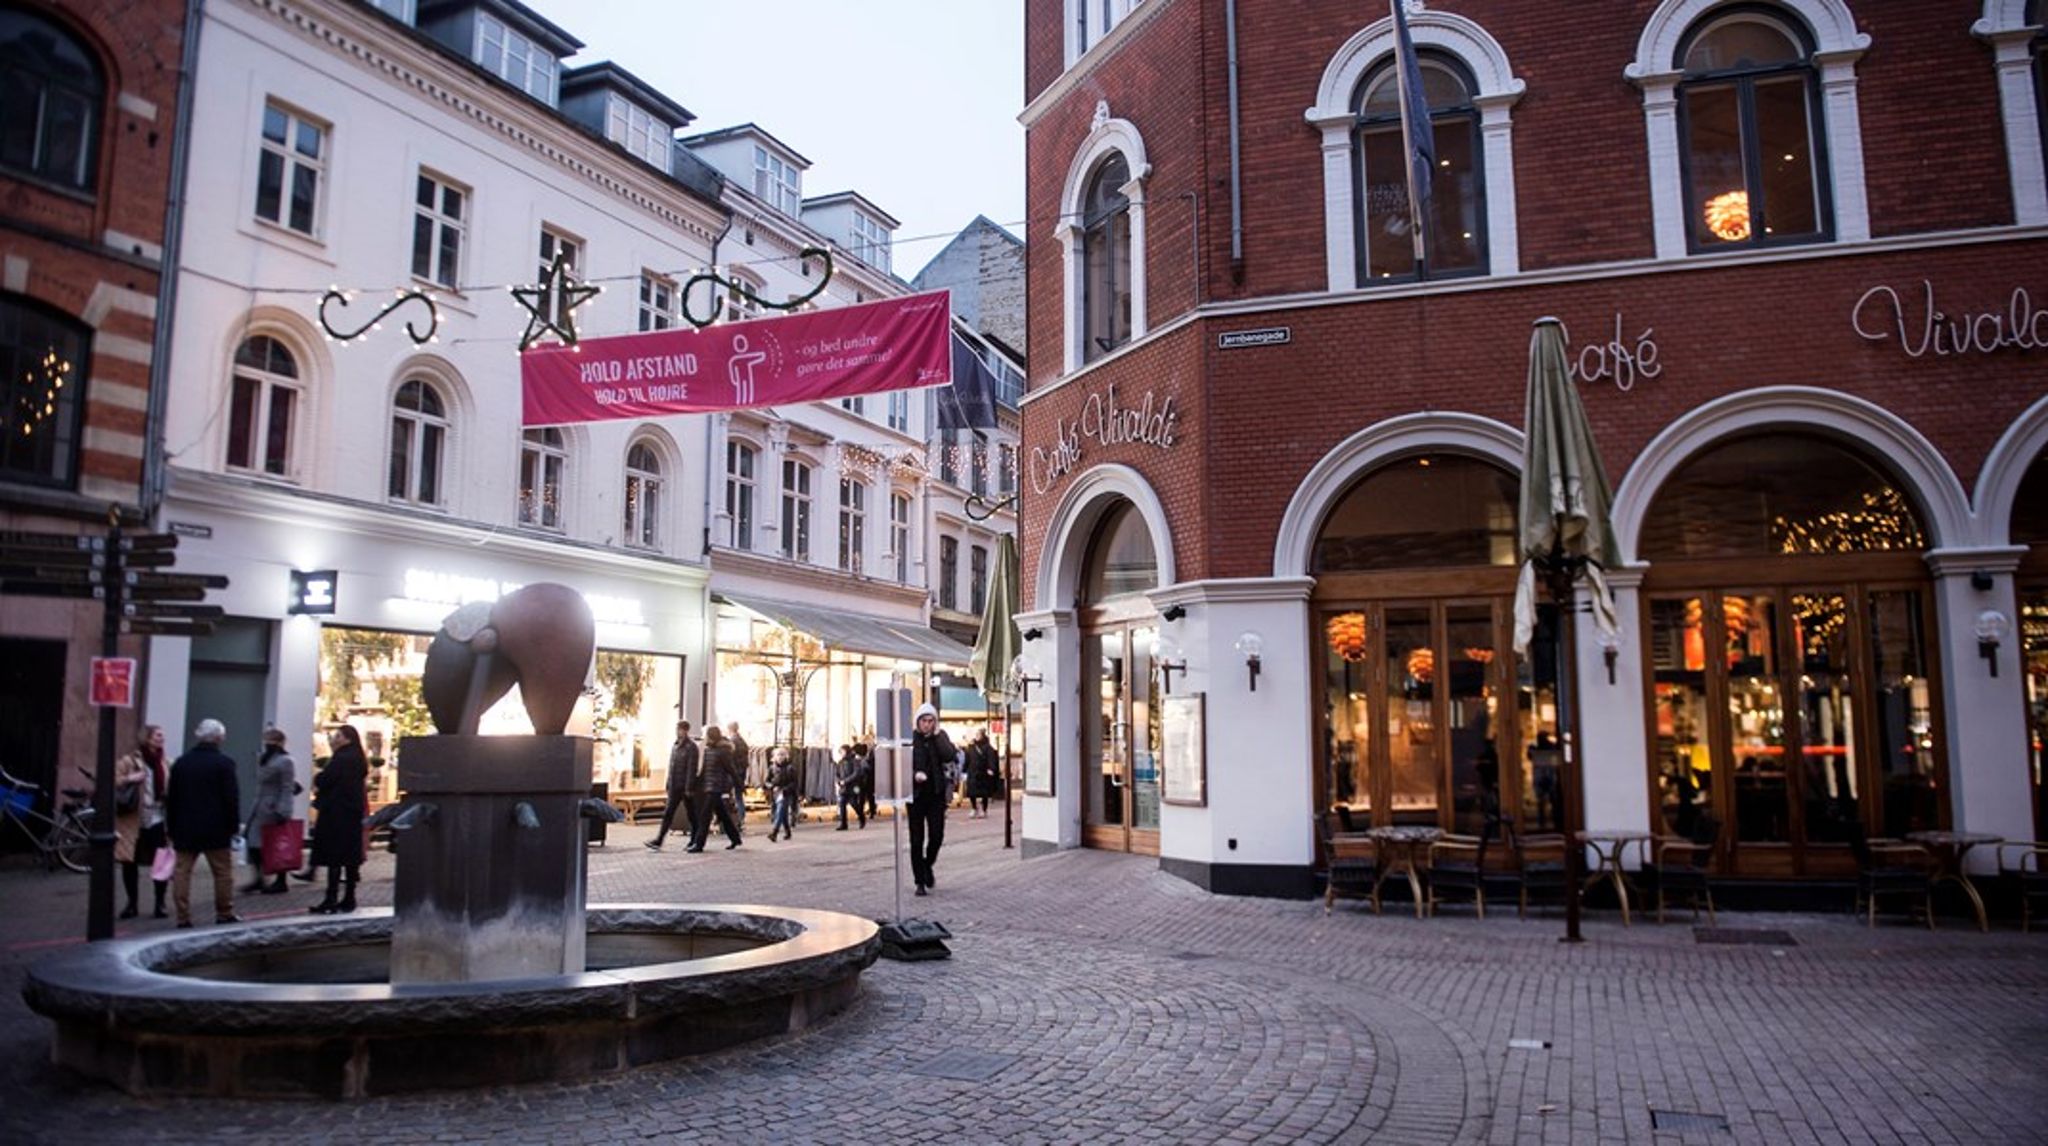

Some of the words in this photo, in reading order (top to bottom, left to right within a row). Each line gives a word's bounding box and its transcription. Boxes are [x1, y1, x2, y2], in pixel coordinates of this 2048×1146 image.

[802, 344, 818, 357] og
[820, 340, 841, 353] bed
[843, 333, 878, 351] andre
[1223, 331, 1285, 346] Jernbanegade
[581, 361, 621, 382] HOLD
[626, 353, 698, 381] AFSTAND
[825, 356, 844, 371] det
[594, 387, 627, 405] HOLD
[628, 387, 647, 403] TIL
[1031, 418, 1081, 494] Café
[1082, 383, 1175, 448] Vivaldi
